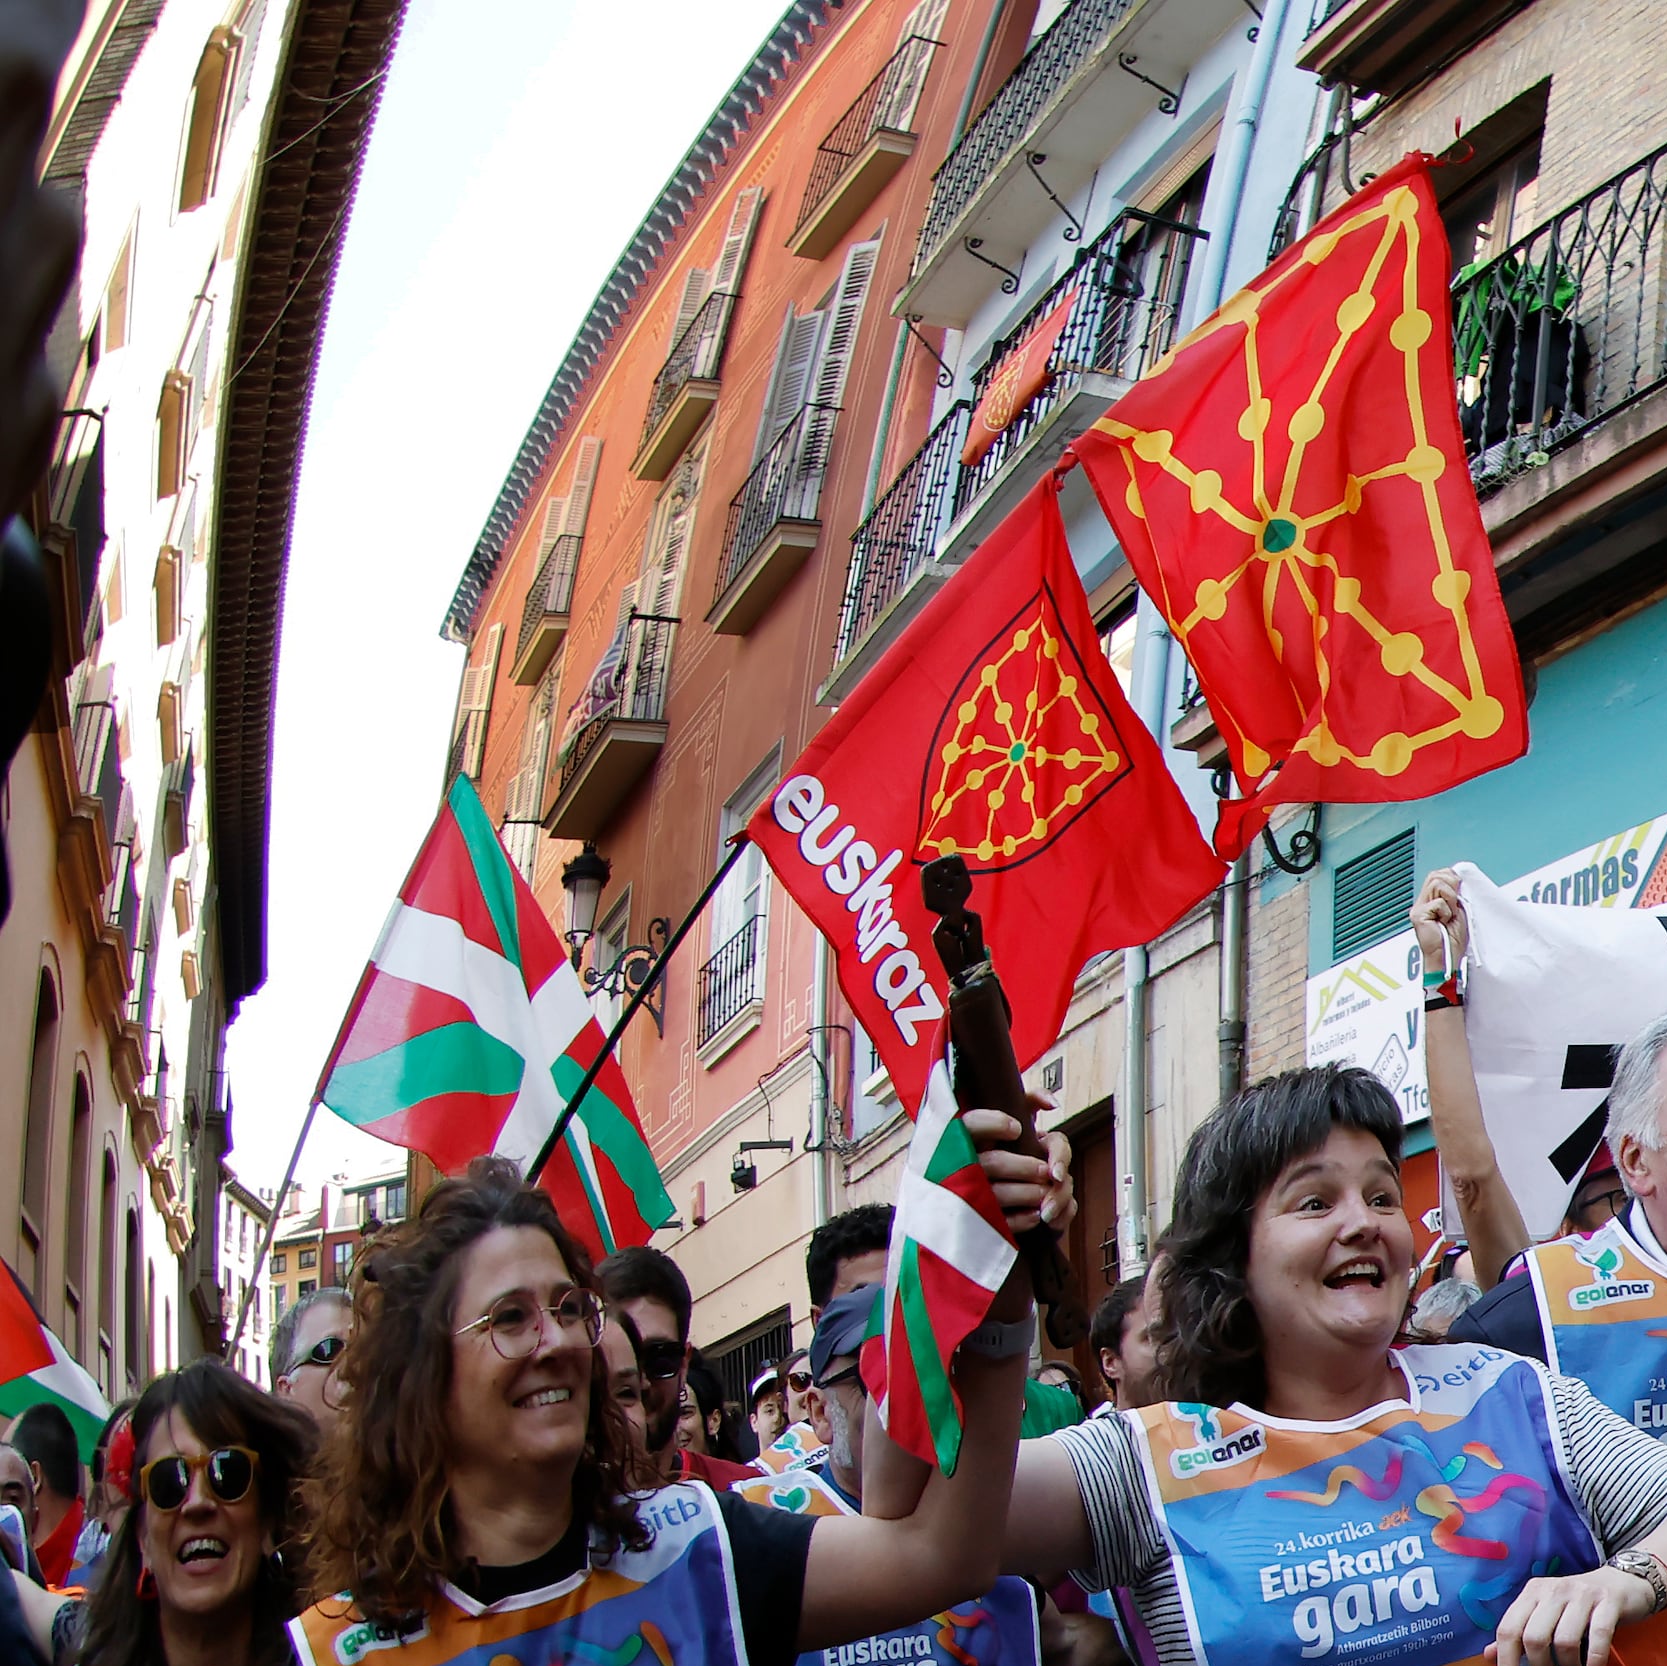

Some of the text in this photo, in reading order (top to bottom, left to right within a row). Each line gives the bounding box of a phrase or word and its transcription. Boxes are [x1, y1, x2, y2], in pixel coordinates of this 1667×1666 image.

[1576, 1281, 1650, 1305] goiener
[1443, 1348, 1505, 1386] eitb
[1178, 1426, 1262, 1471] goiener
[1275, 1503, 1411, 1557] 24.korrika aek
[1259, 1535, 1424, 1602] Euskara
[1293, 1565, 1440, 1659] gara
[1336, 1612, 1450, 1655] Atharratzetik Bilbora
[1430, 1631, 1454, 1648] 29ra
